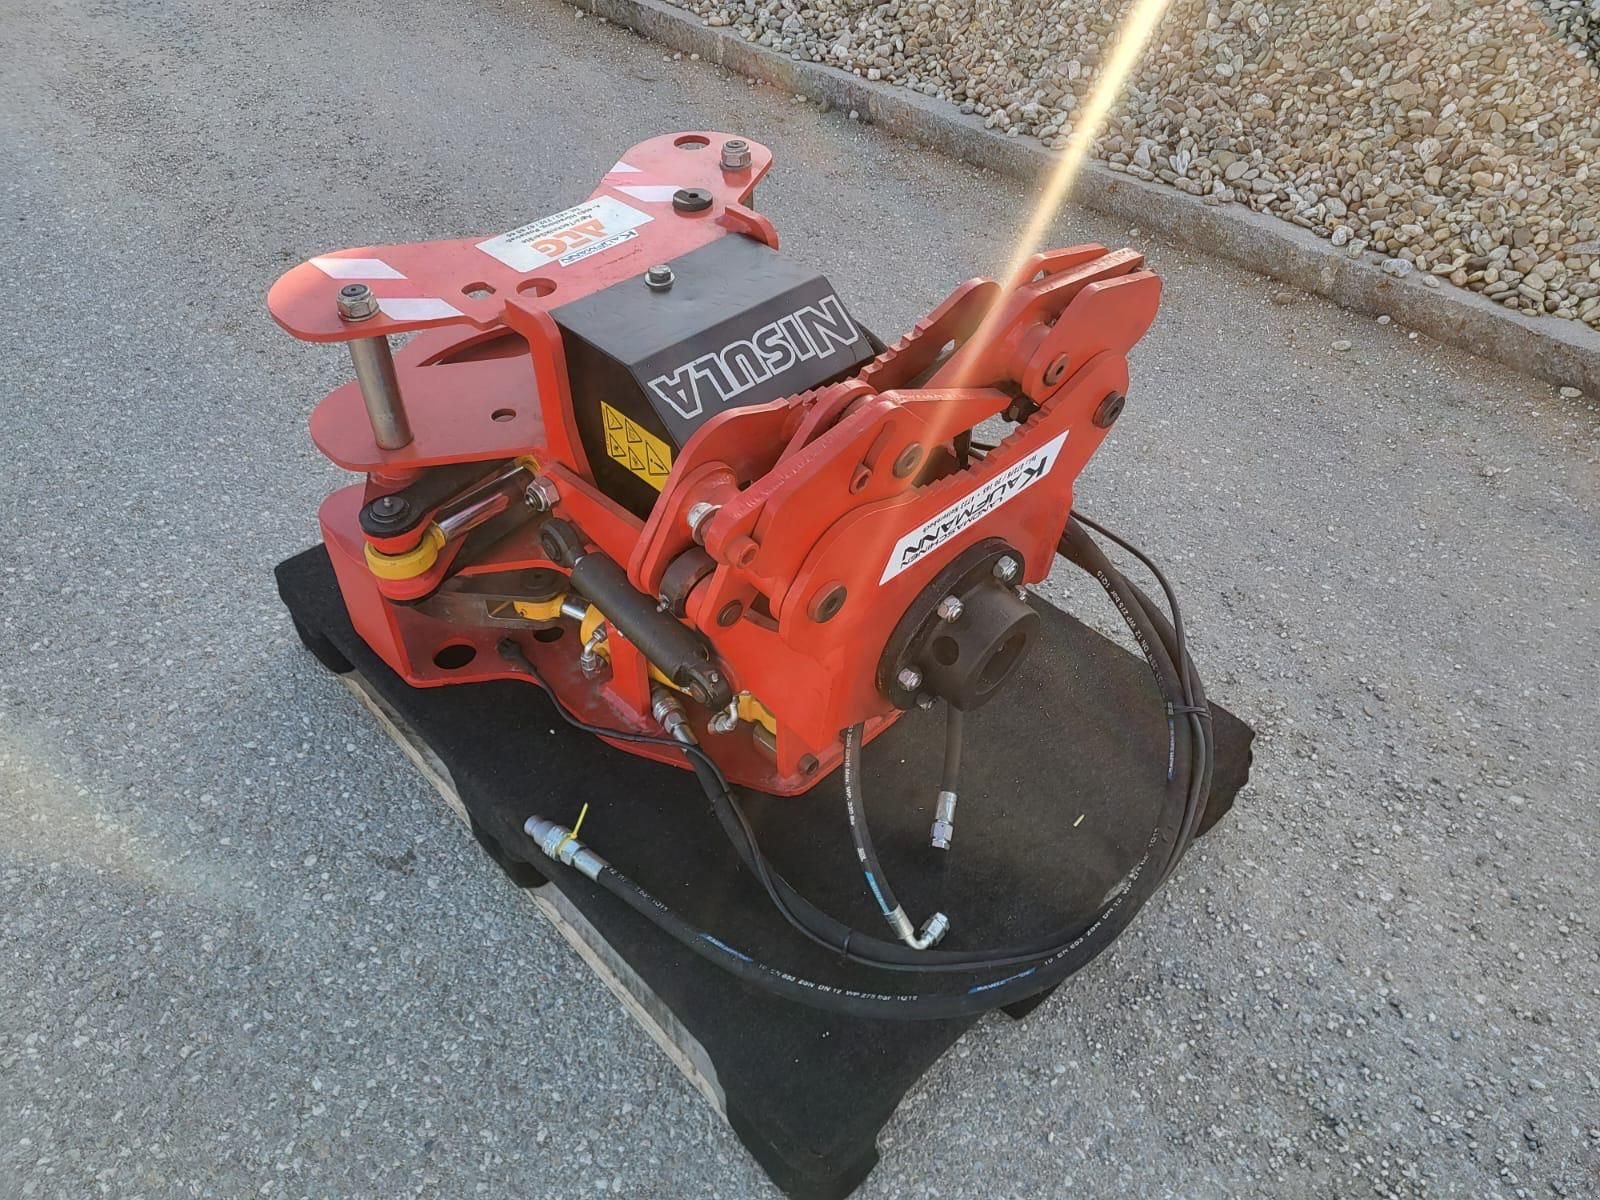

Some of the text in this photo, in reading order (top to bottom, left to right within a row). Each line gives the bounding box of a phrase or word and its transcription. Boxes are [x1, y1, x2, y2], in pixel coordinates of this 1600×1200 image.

[647, 294, 859, 419] NISULA
[901, 497, 1003, 568] LANDMASCHINEN
[902, 456, 1048, 560] KAUFMANN
